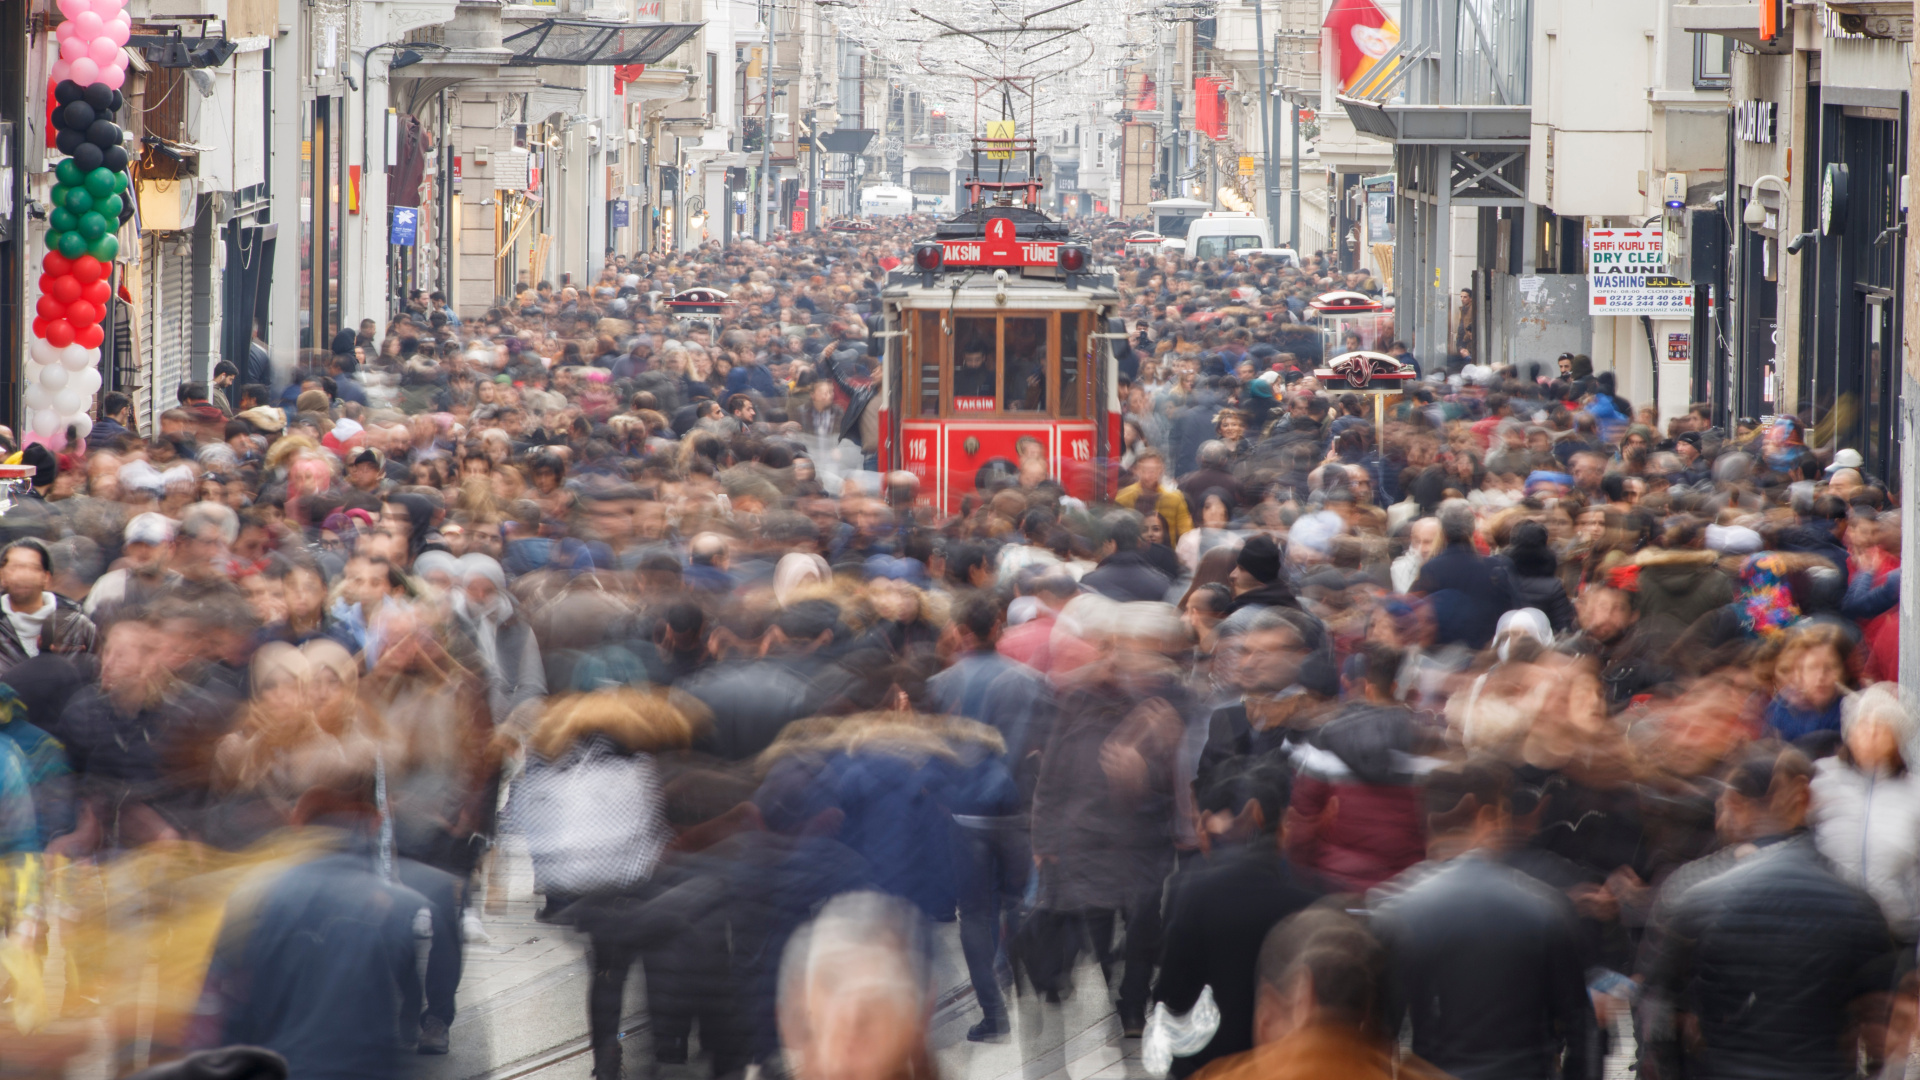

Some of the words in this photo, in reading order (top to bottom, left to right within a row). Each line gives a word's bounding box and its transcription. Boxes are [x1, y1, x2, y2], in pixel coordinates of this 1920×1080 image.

[638, 2, 660, 16] H&M
[994, 220, 1003, 238] 4
[943, 243, 980, 261] AKSİM
[1619, 242, 1644, 250] KURU
[1648, 242, 1662, 250] TE
[1594, 253, 1622, 263] DRY
[1594, 276, 1644, 288] WASHING
[957, 398, 993, 410] TAKSİM
